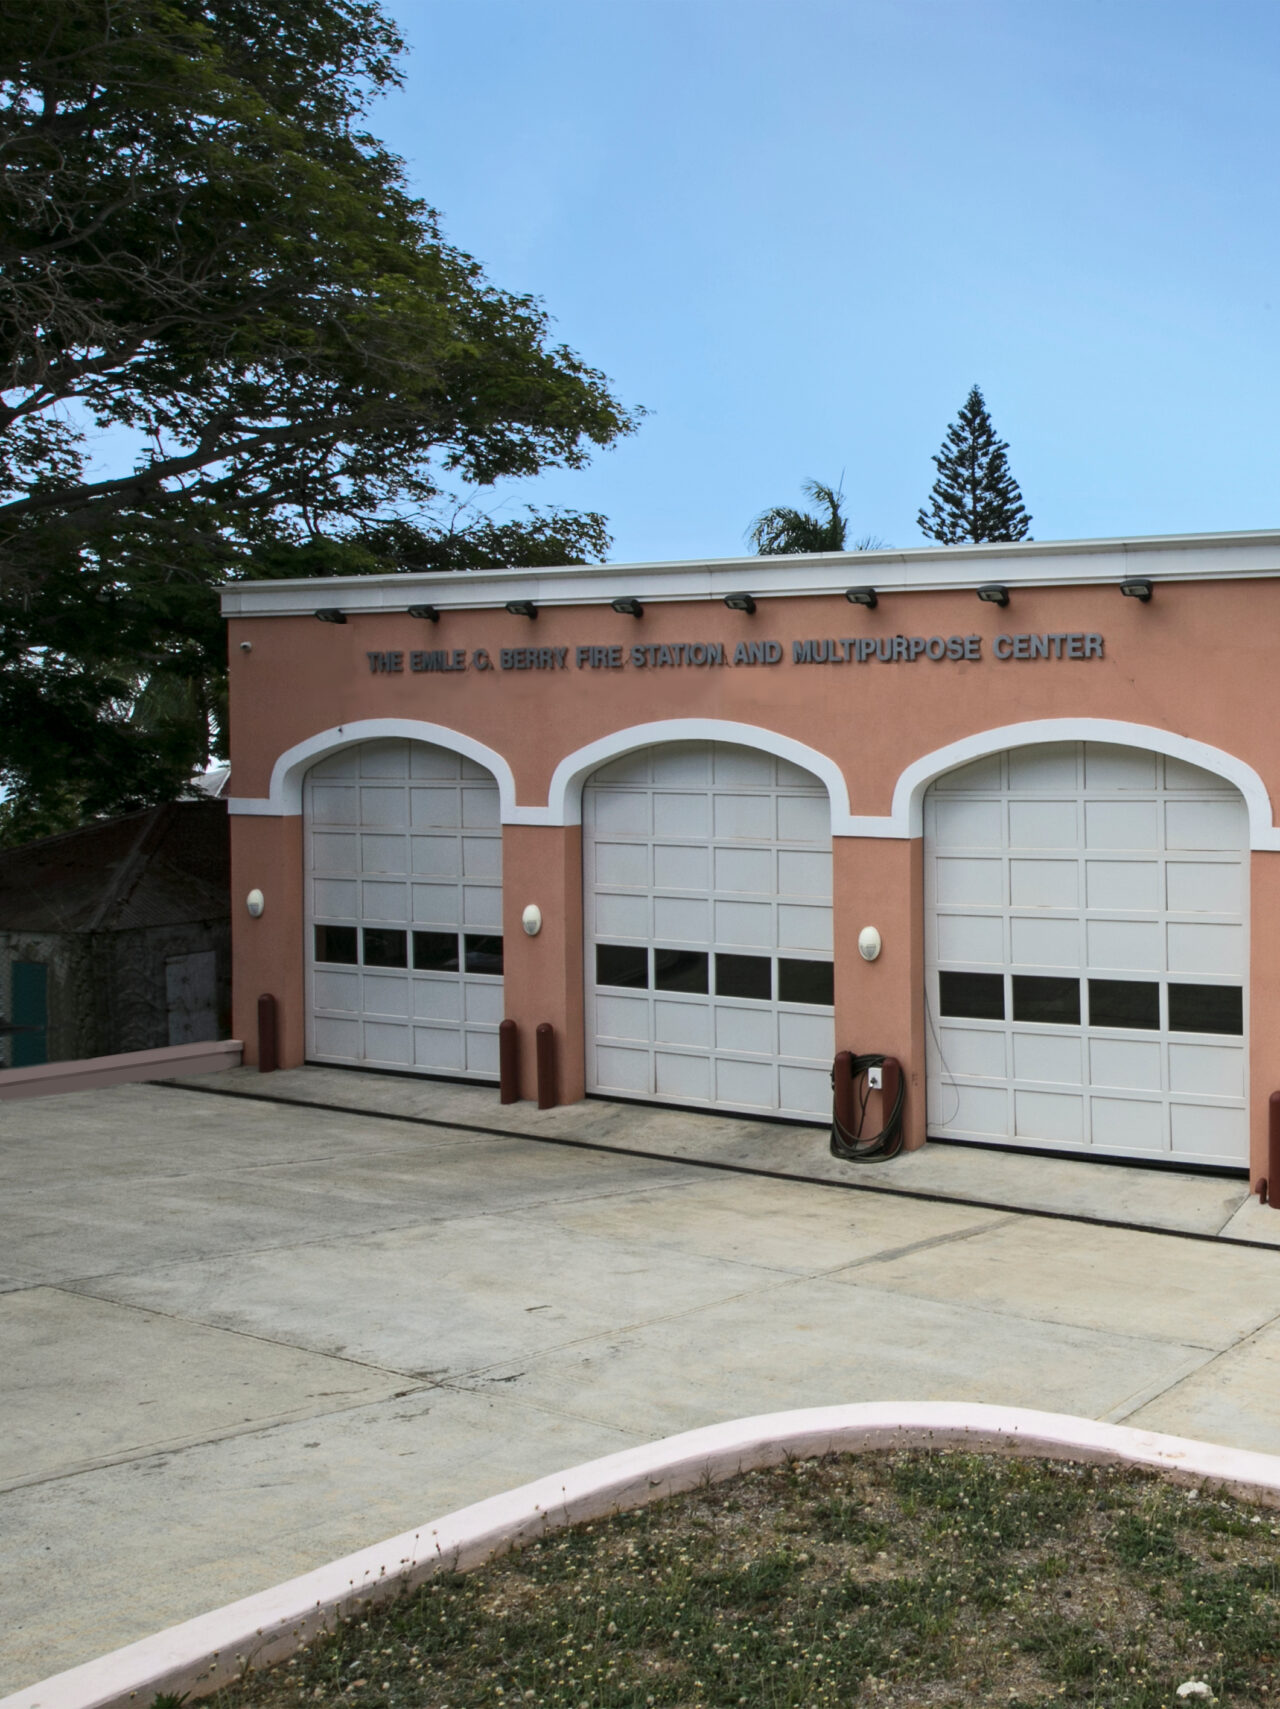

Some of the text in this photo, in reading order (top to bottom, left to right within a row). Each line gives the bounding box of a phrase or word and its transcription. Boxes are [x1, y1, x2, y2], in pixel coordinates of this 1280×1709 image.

[367, 634, 1103, 672] THE EMILE C. BERRY FIRE STATION AND MULTIPURPOSE CENTER
